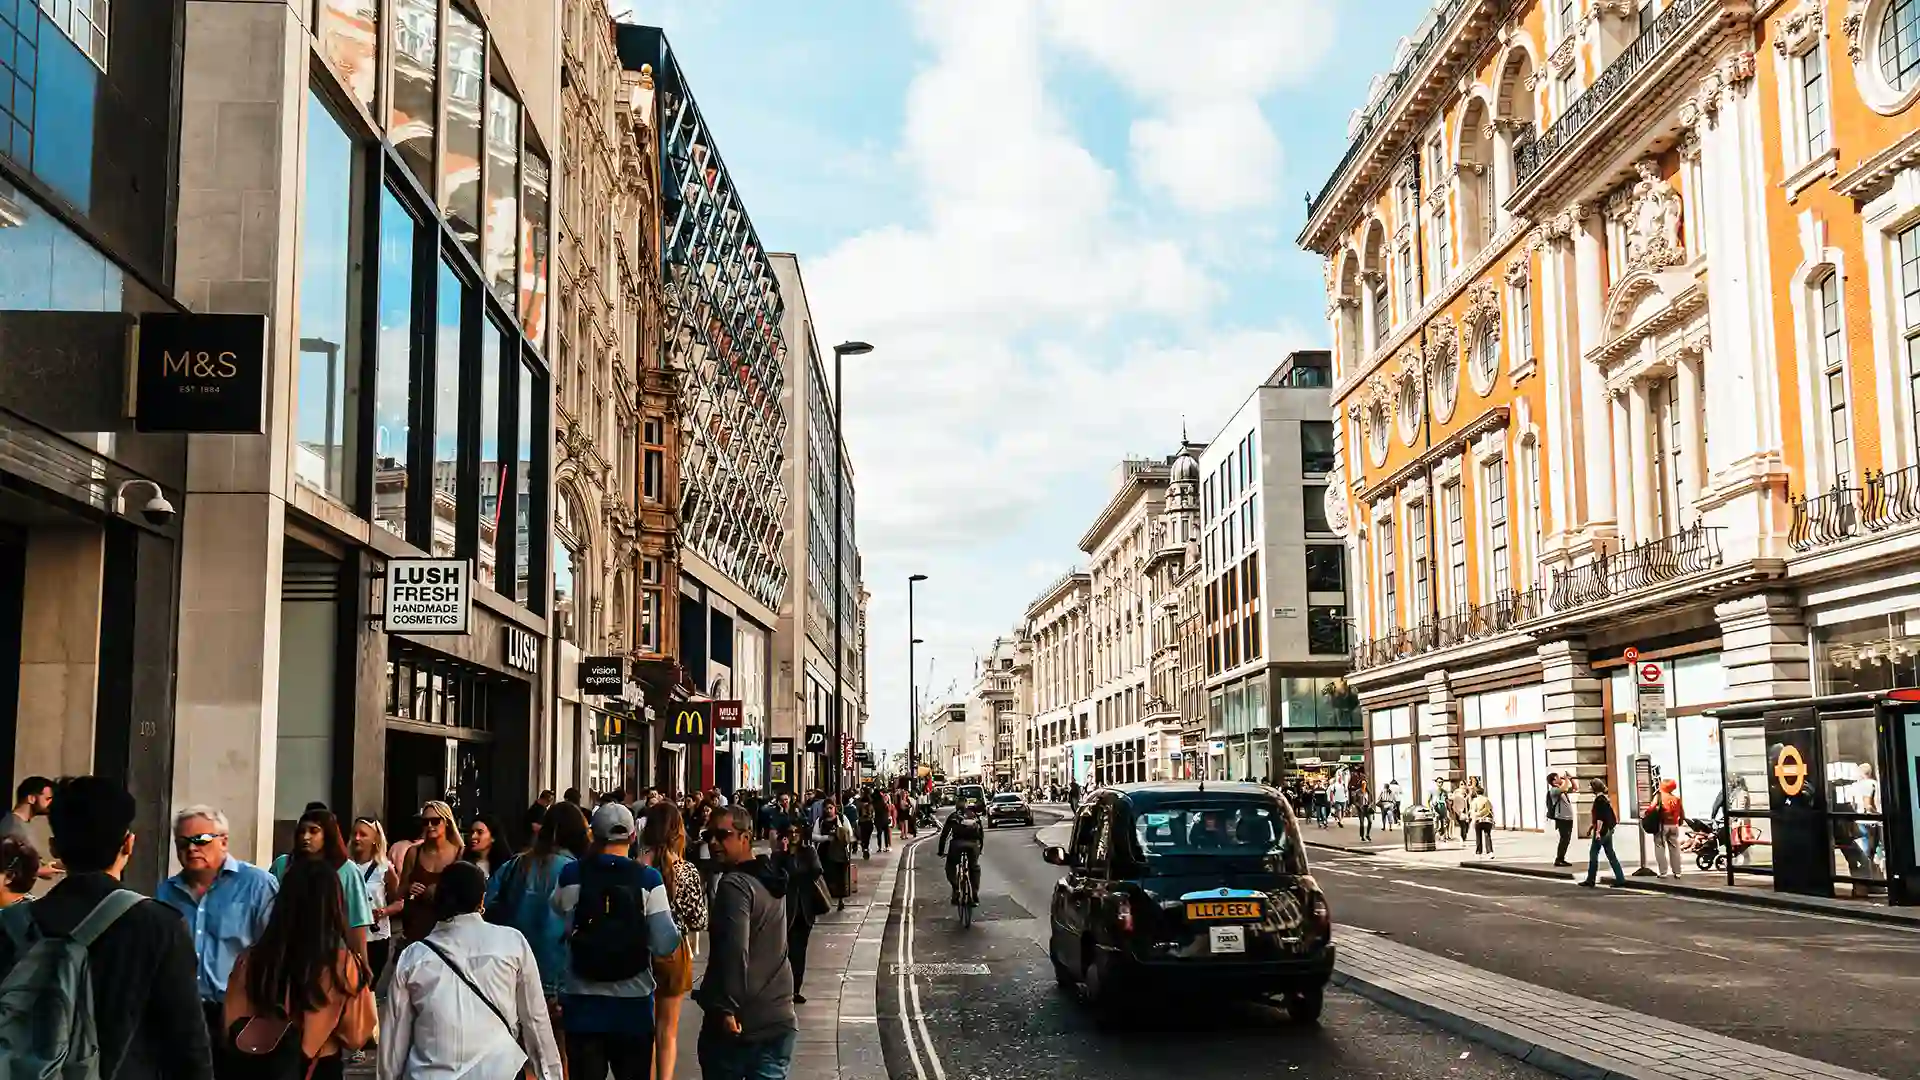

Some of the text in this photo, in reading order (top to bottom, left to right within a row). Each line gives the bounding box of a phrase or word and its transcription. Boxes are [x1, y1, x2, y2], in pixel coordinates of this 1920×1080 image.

[163, 350, 237, 378] M&S
[394, 567, 460, 585] LUSH
[393, 586, 459, 602] FRESH
[392, 604, 458, 613] HANDMADE
[392, 615, 458, 625] COSMETICS
[508, 626, 538, 674] LUSH
[591, 665, 617, 675] vision
[586, 676, 621, 685] express
[719, 707, 738, 716] MUJI
[808, 733, 824, 744] JD
[1195, 903, 1253, 917] LL12 EEX
